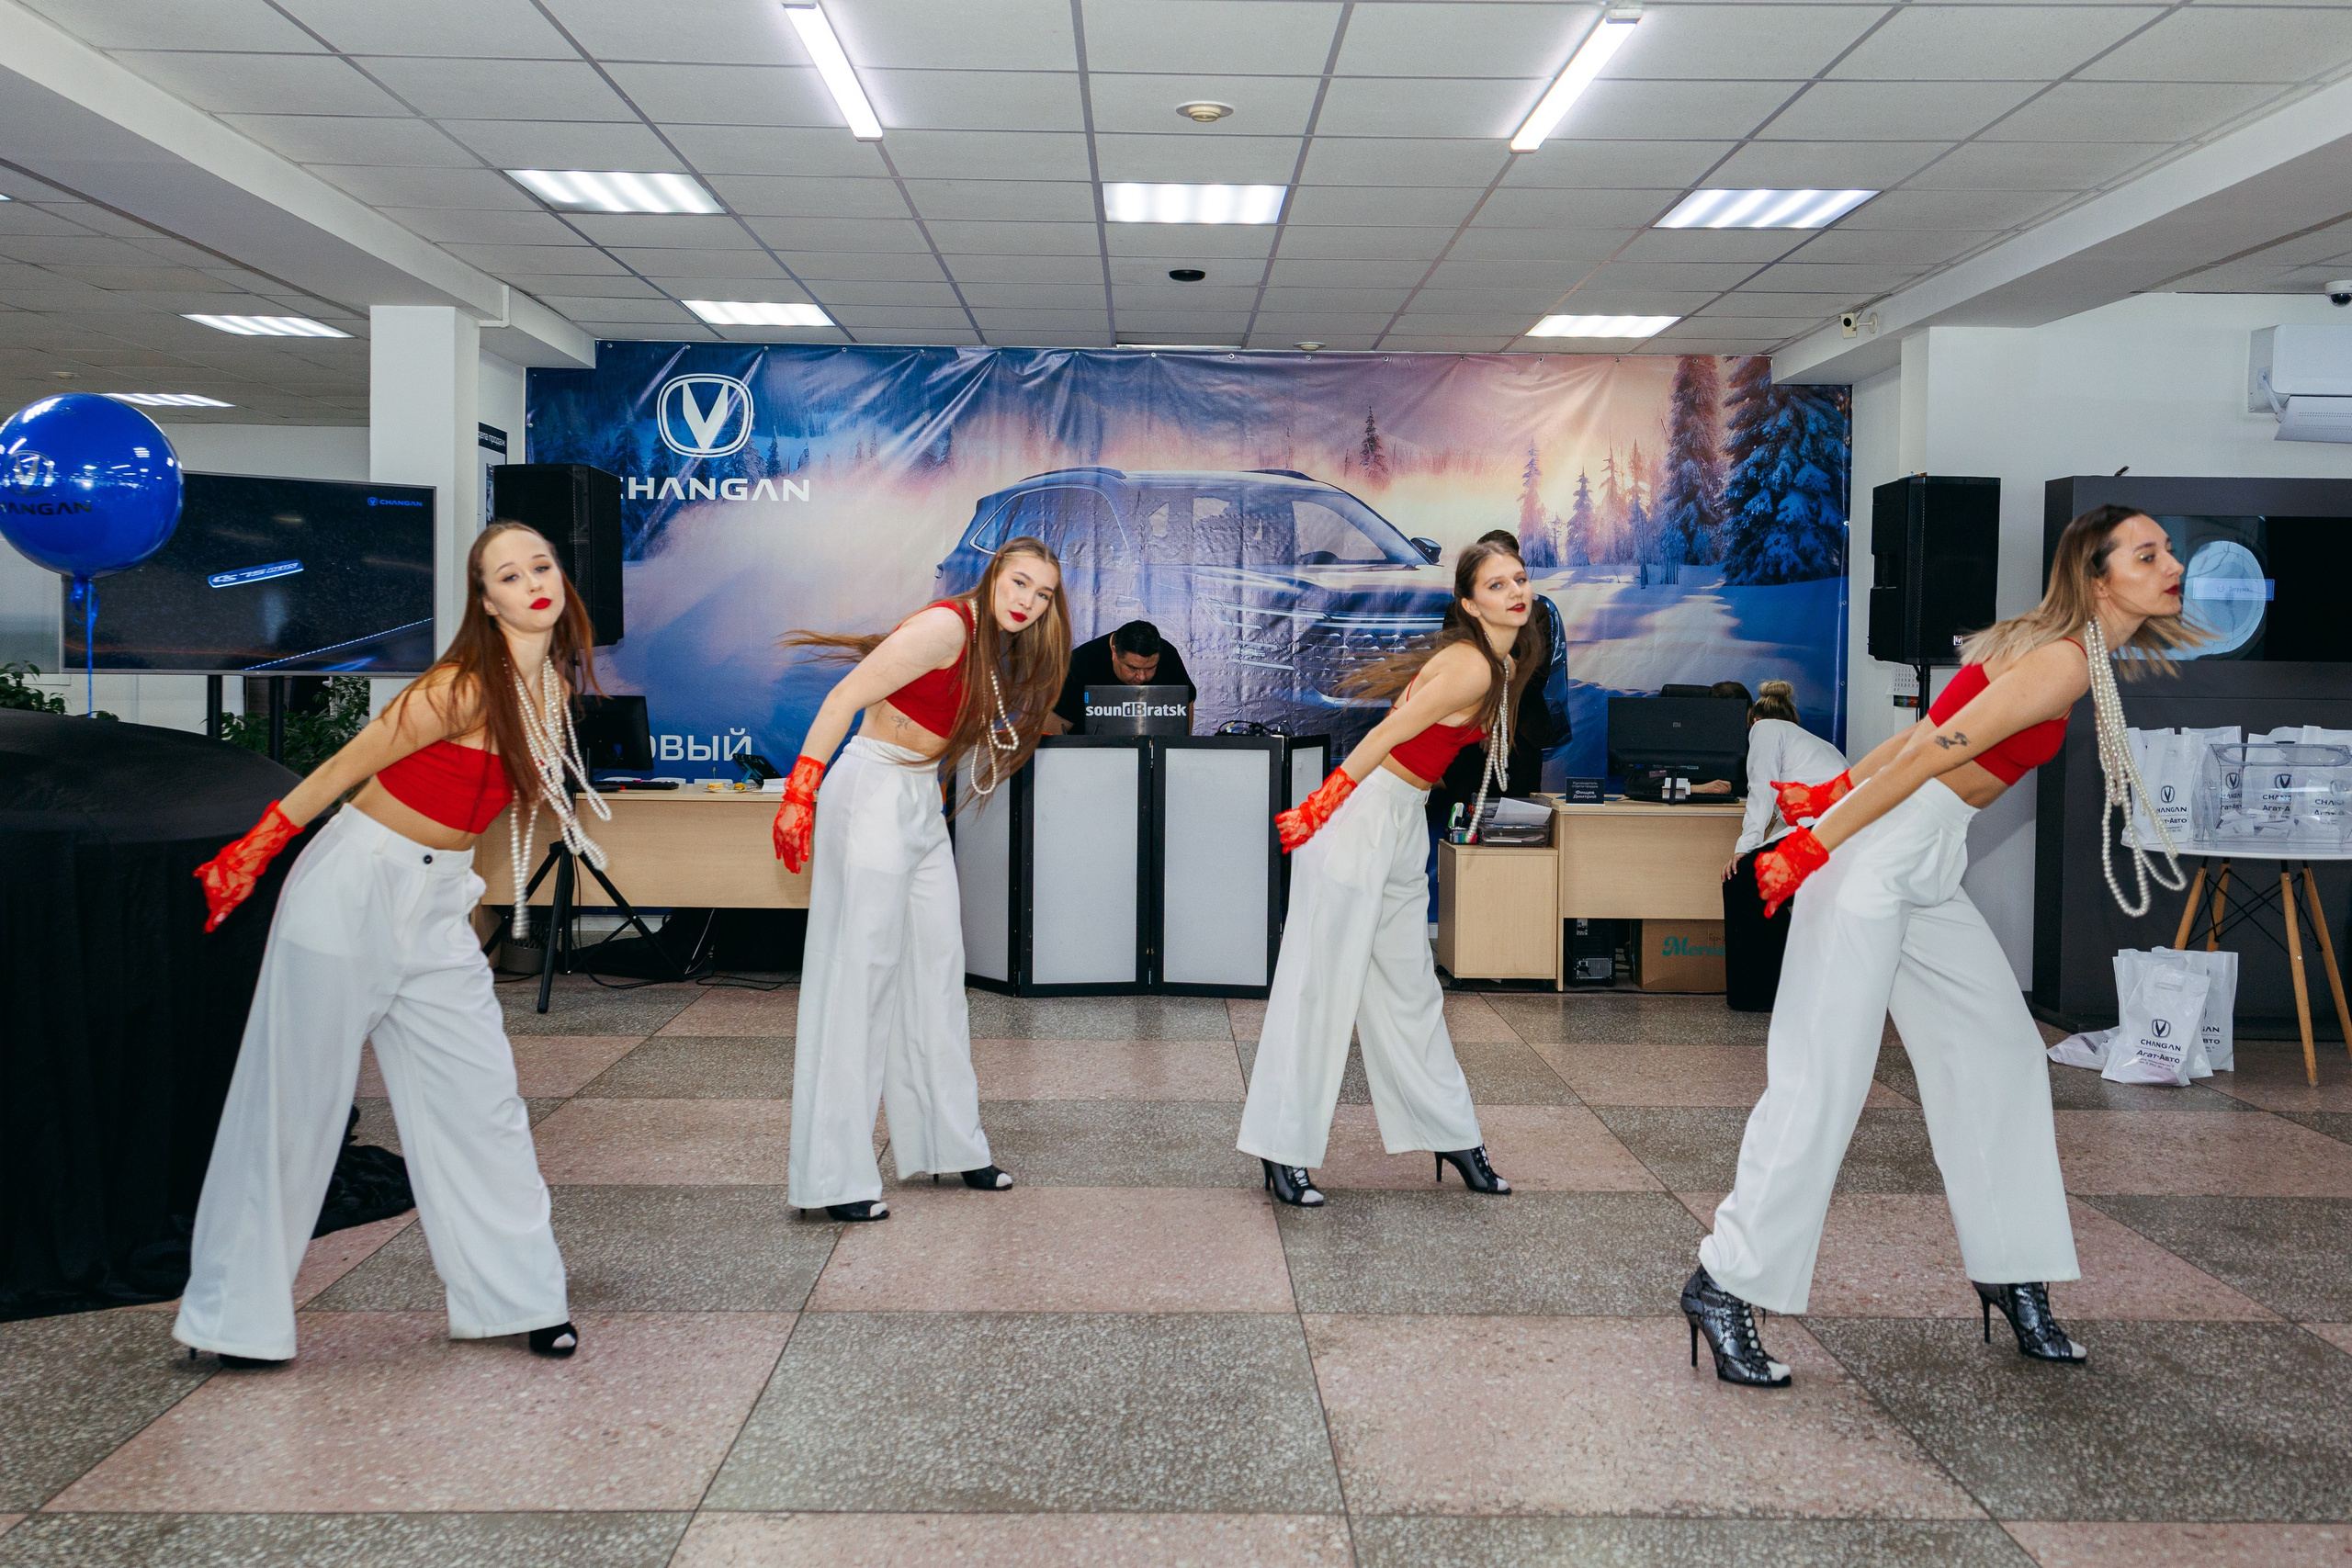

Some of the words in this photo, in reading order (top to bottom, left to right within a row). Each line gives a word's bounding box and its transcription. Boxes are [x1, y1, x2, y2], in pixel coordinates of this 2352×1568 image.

[620, 477, 810, 502] HANGAN
[0, 502, 91, 515] ANGAN
[1085, 702, 1187, 716] soundBratsk
[650, 728, 752, 761] ВЫЙ
[2140, 1039, 2182, 1052] CHANGAN
